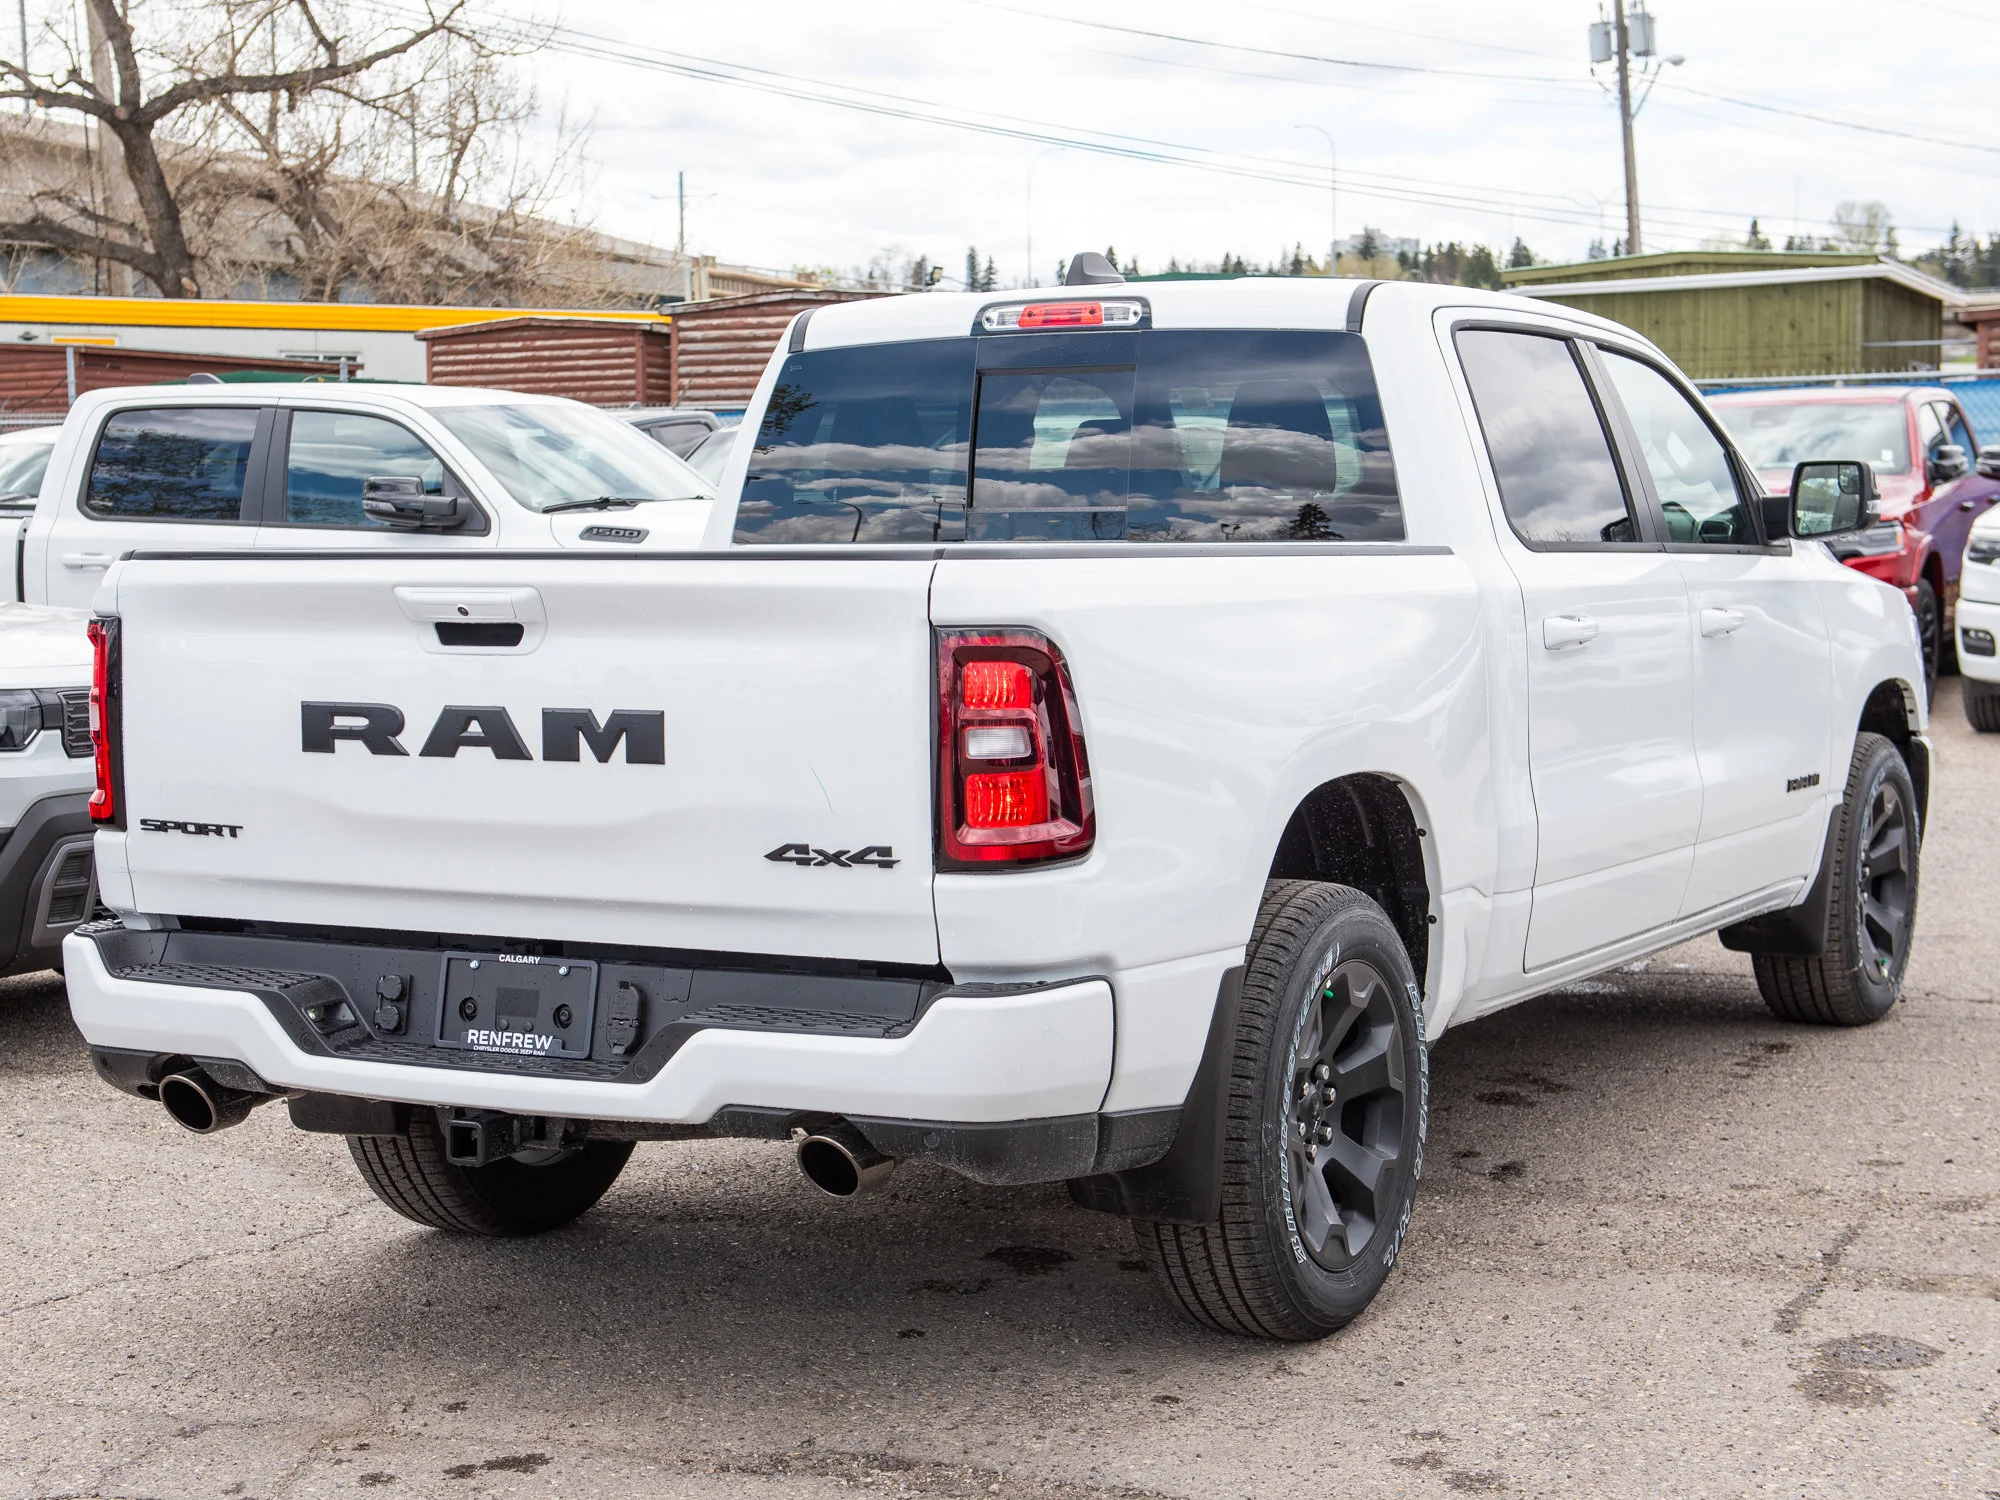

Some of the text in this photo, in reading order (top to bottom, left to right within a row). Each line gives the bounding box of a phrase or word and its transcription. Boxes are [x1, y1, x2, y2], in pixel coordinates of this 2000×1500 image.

[590, 527, 640, 538] 1500
[302, 701, 666, 765] RAM
[140, 818, 243, 839] SPORT
[763, 843, 901, 869] 4x4
[498, 954, 541, 965] CALGARY
[467, 1029, 554, 1050] RENFREW
[473, 1045, 500, 1053] CHRYSLER
